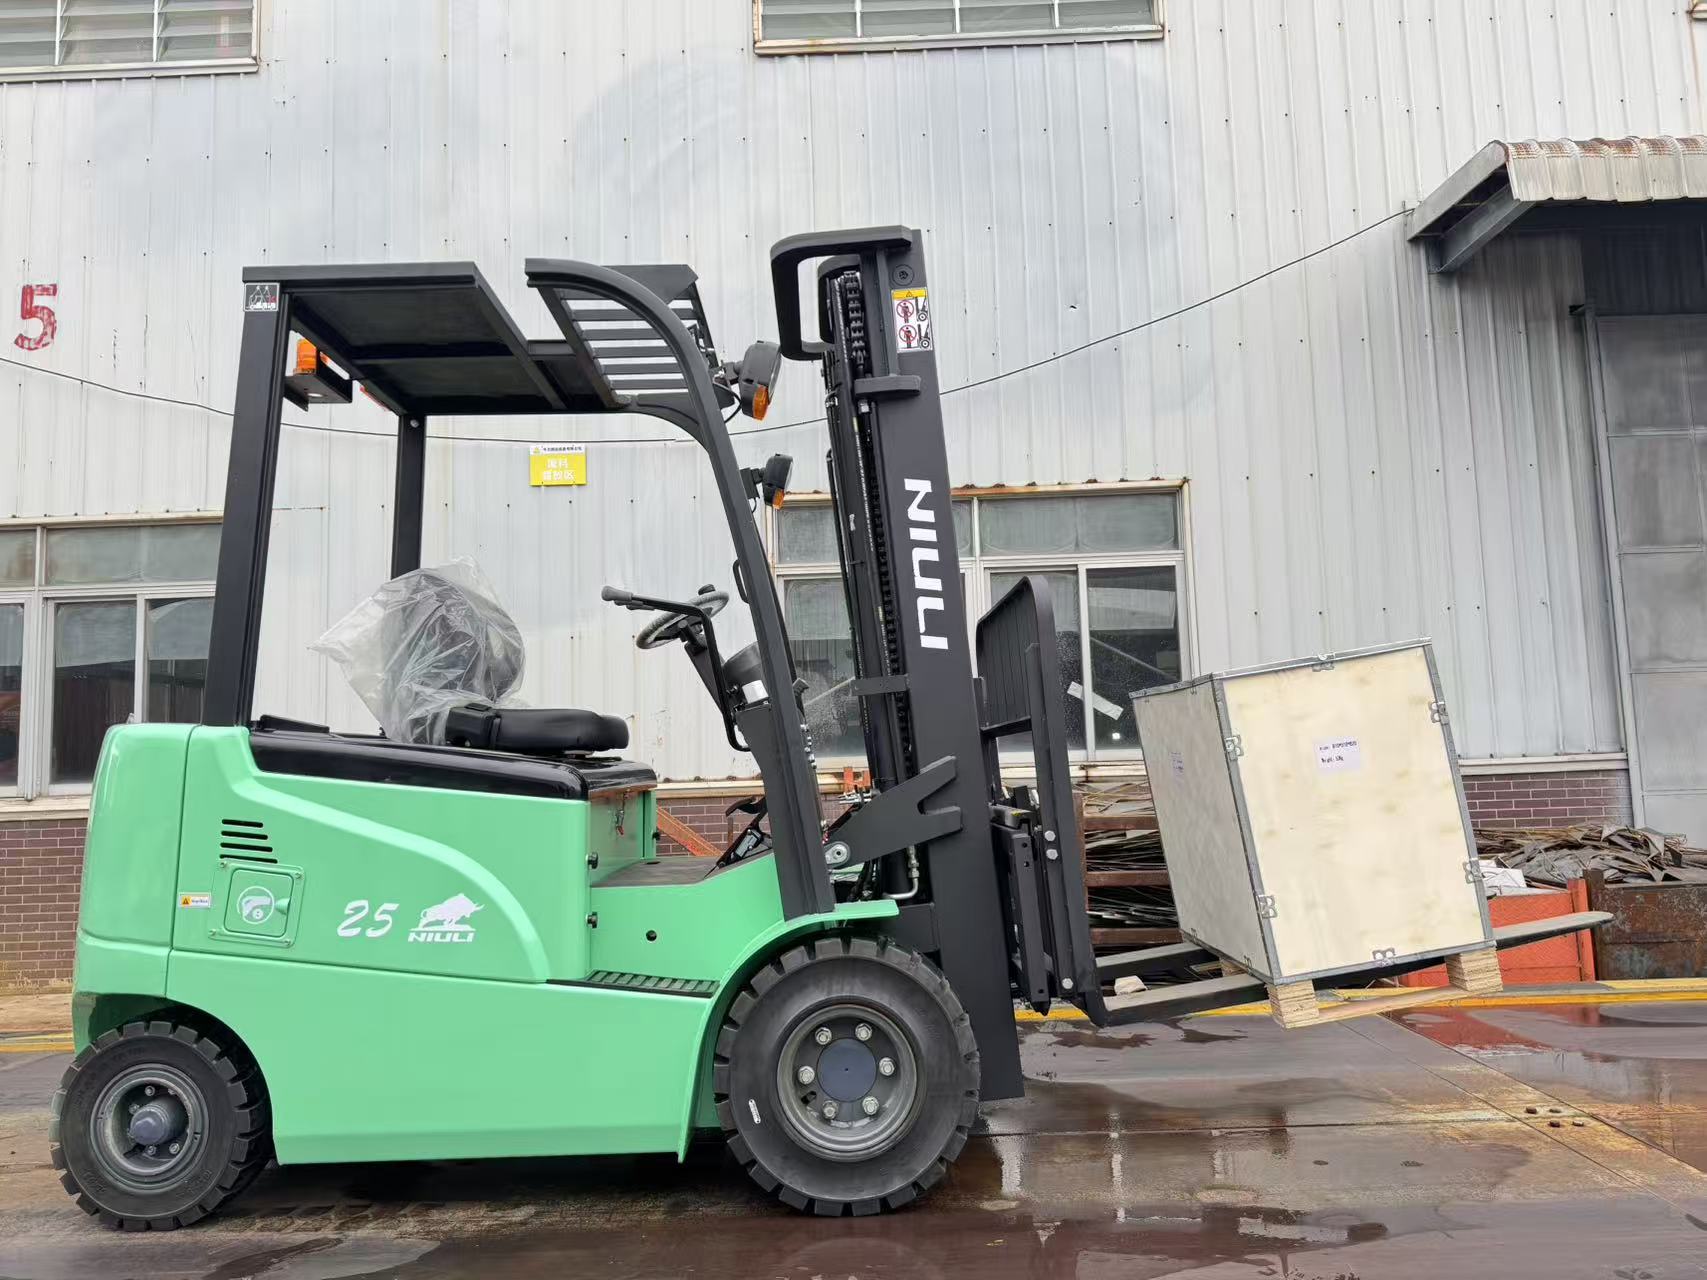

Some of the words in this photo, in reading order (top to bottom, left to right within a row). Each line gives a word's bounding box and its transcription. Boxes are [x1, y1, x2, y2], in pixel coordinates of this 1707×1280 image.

[14, 284, 57, 350] 5
[904, 478, 949, 650] NIULI
[337, 899, 400, 938] 25
[408, 932, 475, 943] NIULI
